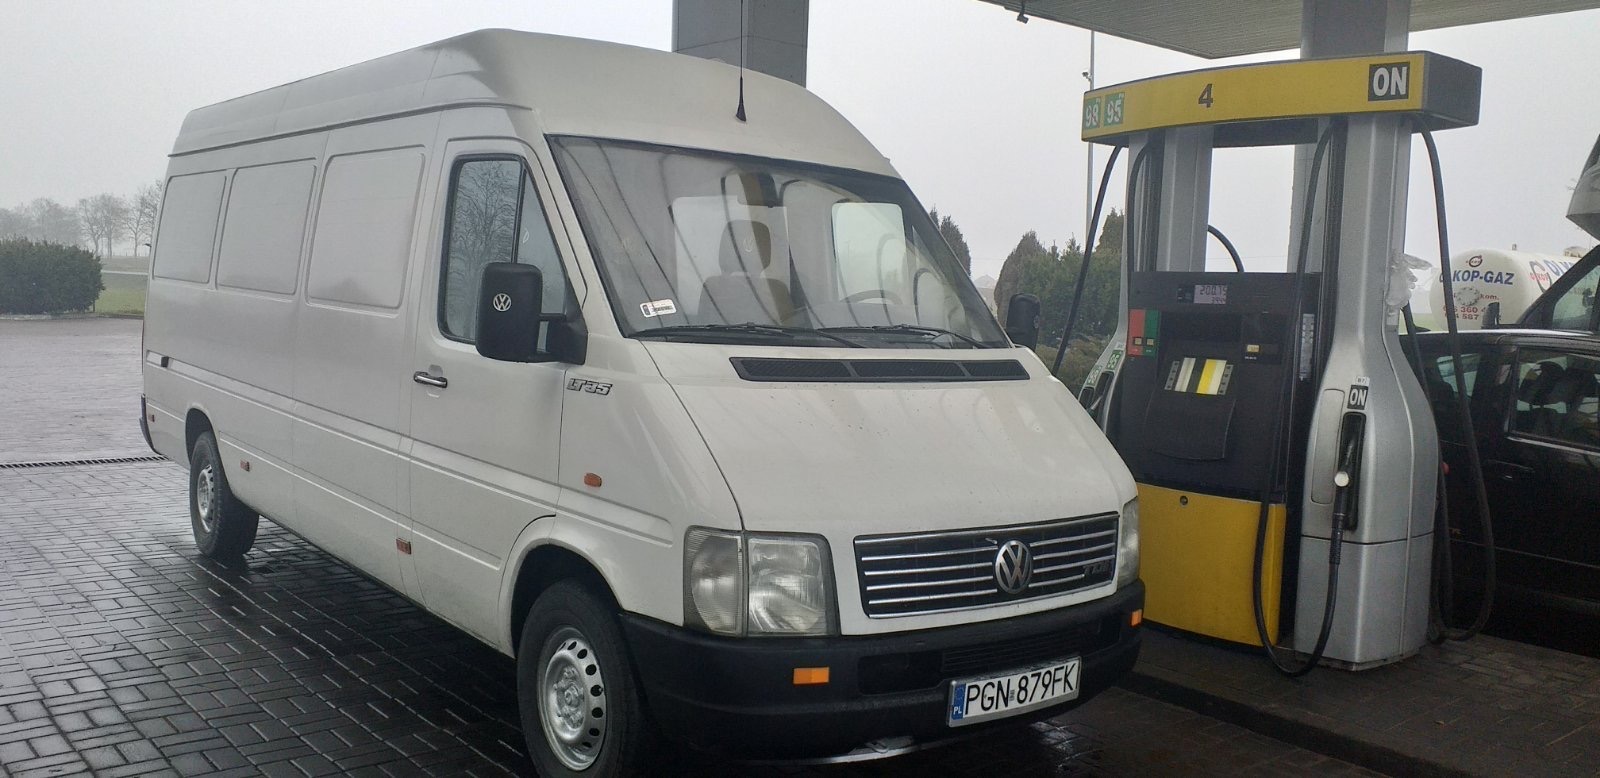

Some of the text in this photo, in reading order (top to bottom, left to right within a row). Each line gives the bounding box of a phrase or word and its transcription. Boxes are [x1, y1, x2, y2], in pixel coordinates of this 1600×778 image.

[1373, 66, 1408, 96] ON
[1198, 83, 1214, 108] 4
[1107, 99, 1122, 124] 95
[1350, 388, 1367, 406] ON
[964, 662, 1077, 716] PGN 879FK
[953, 705, 963, 715] PL
